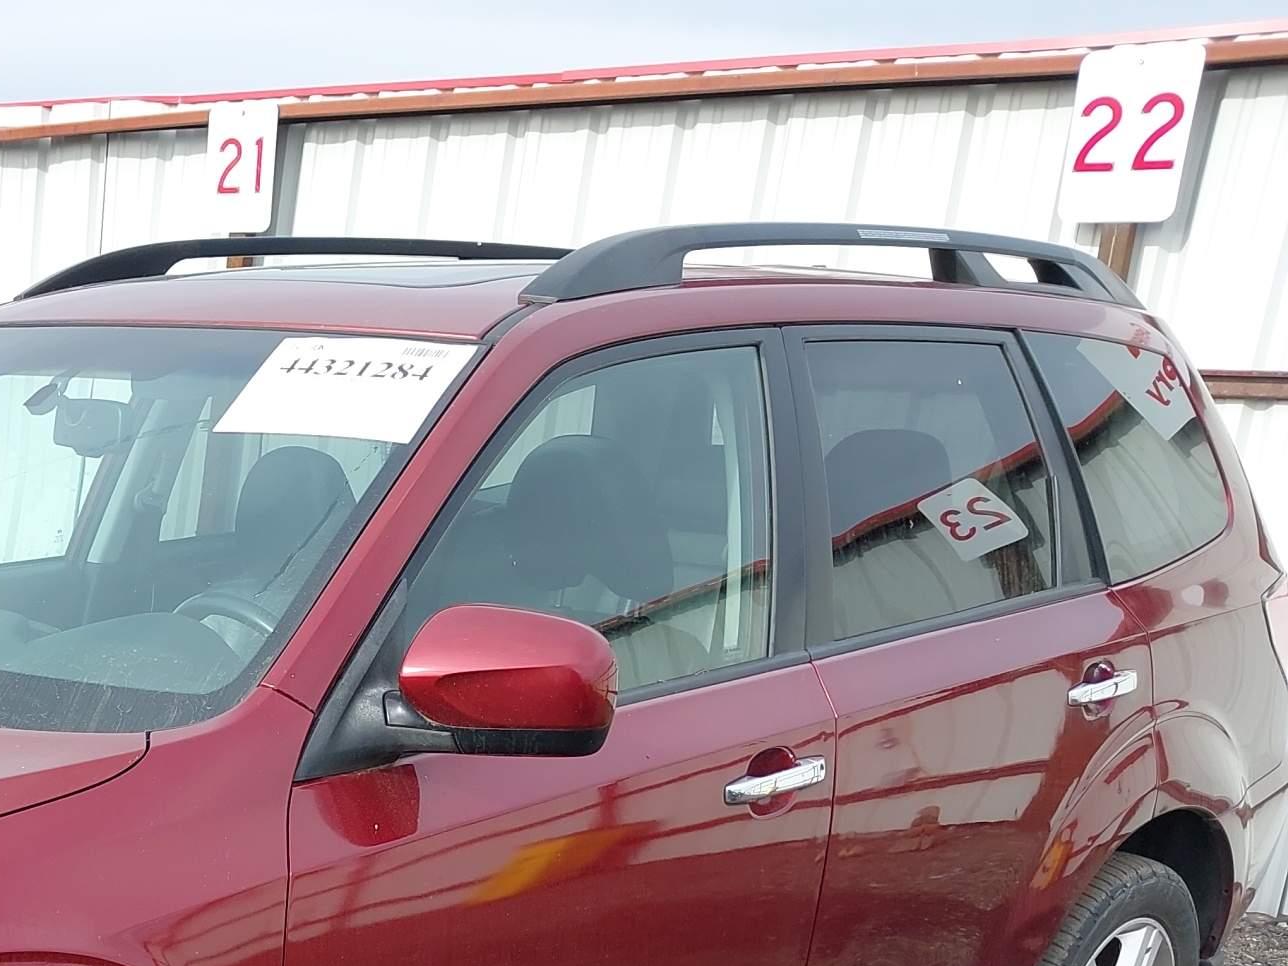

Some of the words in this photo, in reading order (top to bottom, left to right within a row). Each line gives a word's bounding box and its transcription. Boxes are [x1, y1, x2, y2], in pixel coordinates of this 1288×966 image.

[1072, 92, 1185, 172] 22
[217, 136, 264, 193] 21
[280, 357, 434, 381] 44321284
